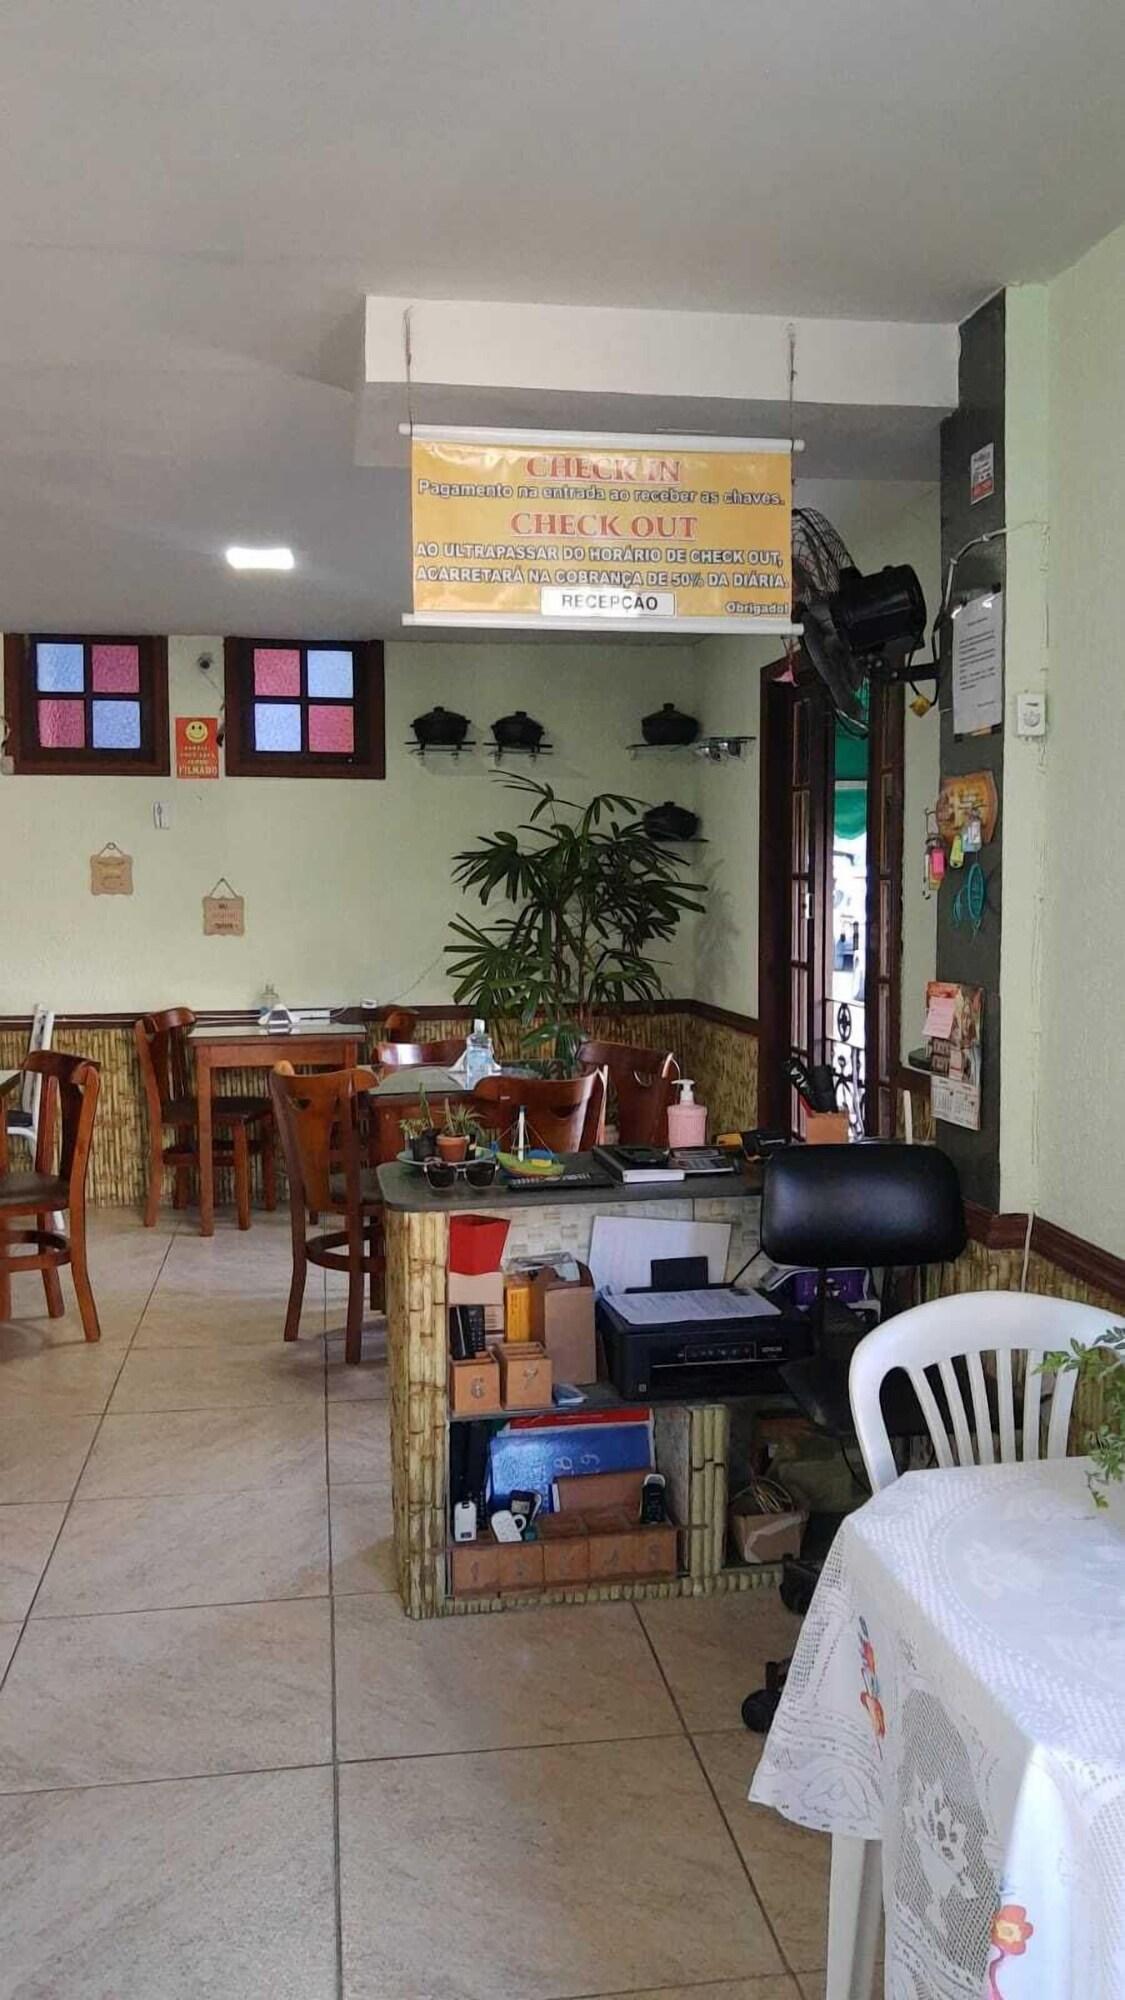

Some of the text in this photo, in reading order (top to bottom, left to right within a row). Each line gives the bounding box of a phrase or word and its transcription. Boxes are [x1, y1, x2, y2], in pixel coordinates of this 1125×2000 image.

[526, 456, 680, 482] CHECK IN
[418, 479, 786, 505] Pagamento na entrada ao receber as chaves.
[510, 512, 698, 538] CHECK OUT
[416, 542, 784, 567] AO ULTRAPASSAR DO HORÁRIO DE CHECK OUT,
[416, 565, 524, 584] ACARRETARÁ
[528, 570, 551, 584] NA
[555, 570, 643, 588] COBRANÇA
[647, 571, 668, 587] DE
[672, 572, 703, 588] 50%
[708, 573, 729, 588] DA
